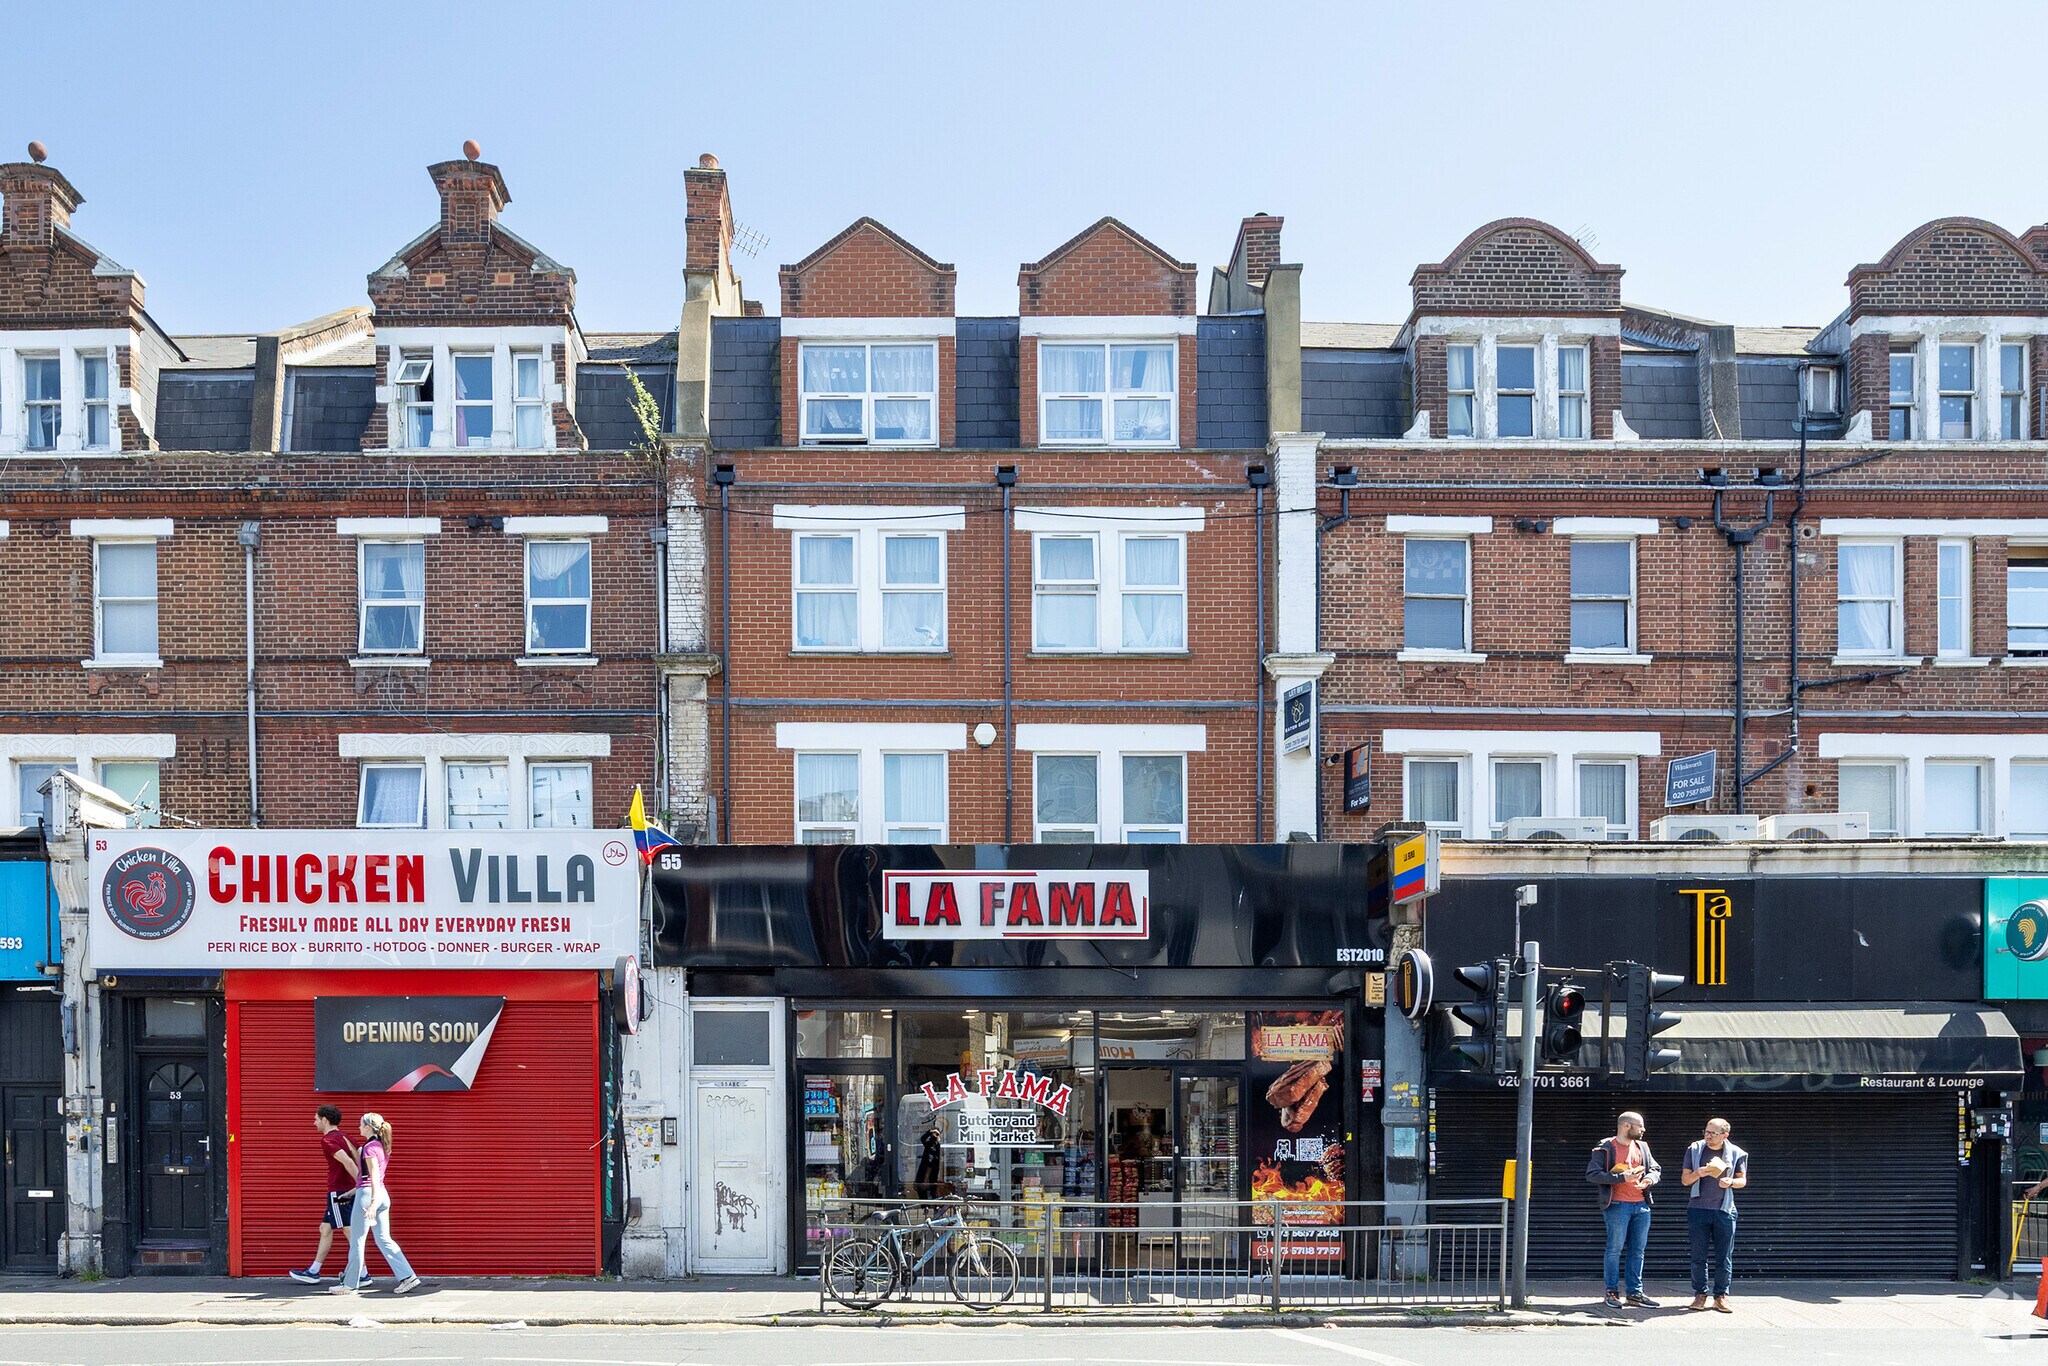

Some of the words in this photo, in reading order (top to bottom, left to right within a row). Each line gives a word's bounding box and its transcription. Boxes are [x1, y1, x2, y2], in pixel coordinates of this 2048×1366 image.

[1675, 761, 1702, 770] Winkworth
[1673, 780, 1688, 789] FOR
[1690, 776, 1705, 787] SALE
[1672, 792, 1685, 800] 020
[1685, 788, 1699, 797] 7587
[1350, 799, 1359, 808] For
[1358, 795, 1369, 805] Sale
[95, 840, 107, 851] 53
[115, 850, 156, 873] Chicken
[161, 851, 182, 876] Villa
[661, 853, 682, 870] 55
[208, 845, 426, 904] CHICKEN
[448, 847, 596, 903] VILLA
[895, 882, 962, 926] LA
[979, 882, 1138, 926] FAMA
[117, 919, 136, 934] BURRITO
[163, 920, 182, 934] DONNER
[240, 915, 308, 932] FRESHLY
[314, 917, 358, 932] MADE
[365, 917, 393, 932] ALL
[399, 917, 429, 932] DAY
[435, 917, 517, 932] EVERYDAY
[521, 917, 571, 932] FRESH
[0, 936, 23, 950] 593
[207, 942, 236, 953] PERI
[239, 942, 267, 953] RICE
[271, 942, 298, 953] BOX
[308, 942, 363, 953] BURRITO
[373, 942, 427, 953] HOTDOG
[437, 942, 490, 953] DONNER
[500, 942, 553, 953] BURGER
[563, 942, 601, 953] WRAP
[1336, 948, 1385, 962] EST2010
[343, 1021, 424, 1043] OPENING
[429, 1021, 479, 1043] SOON
[1266, 1033, 1285, 1047] LA
[1290, 1033, 1330, 1047] FAMA
[1498, 1076, 1520, 1087] 020
[1560, 1076, 1590, 1087] 3661
[1860, 1076, 1925, 1088] Restaurant
[1926, 1077, 1935, 1088] &
[1939, 1077, 1984, 1090] Lounge
[170, 1091, 182, 1100] 53
[921, 1072, 968, 1111] LA
[977, 1069, 1073, 1115] FAMA
[958, 1113, 1011, 1127] Butcher
[1011, 1113, 1036, 1127] and
[958, 1129, 985, 1142] Mini
[990, 1129, 1036, 1142] Market
